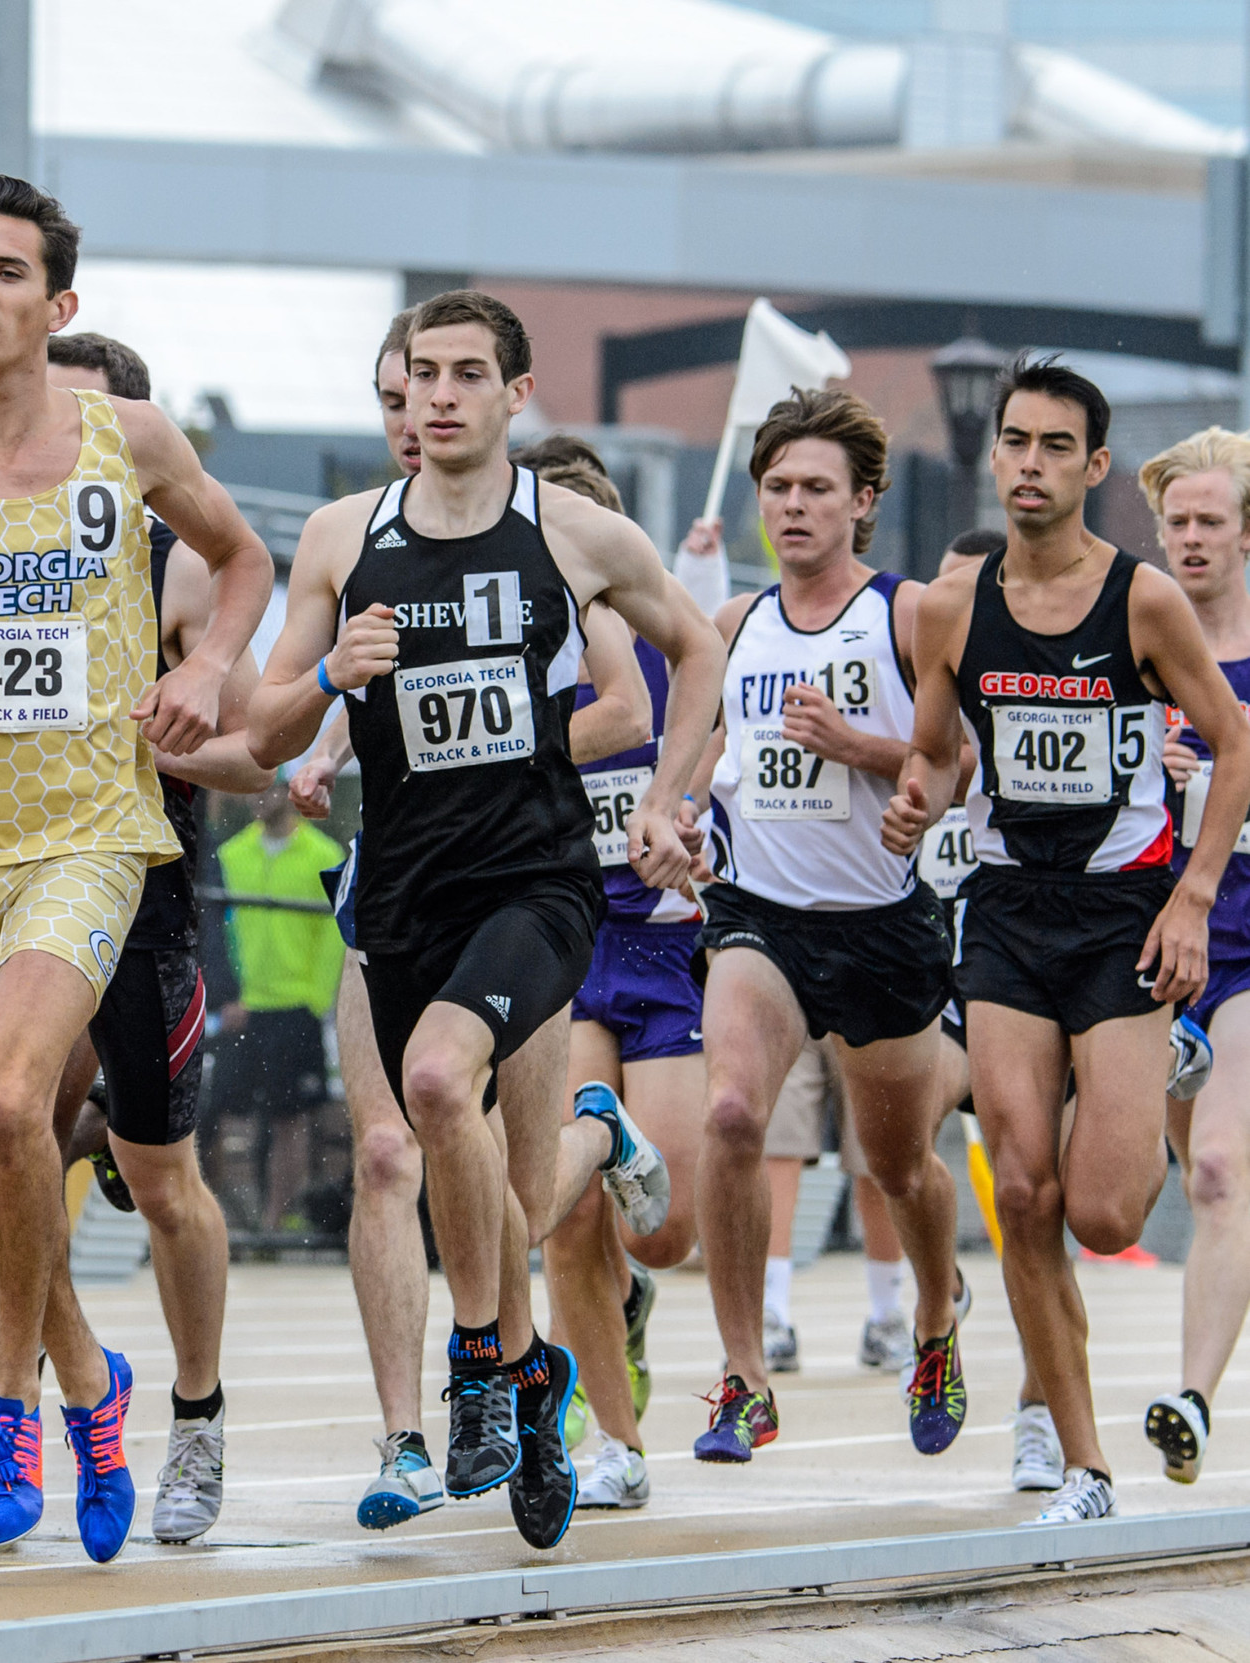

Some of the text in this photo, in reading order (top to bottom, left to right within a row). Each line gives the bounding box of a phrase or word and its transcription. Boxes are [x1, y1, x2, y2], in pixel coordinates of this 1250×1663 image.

[77, 485, 117, 552] 9
[375, 538, 407, 549] adidas
[393, 600, 533, 629] SHEVE
[473, 578, 502, 641] 1
[37, 628, 69, 640] TECH
[404, 667, 516, 691] GEORGIA TECH
[818, 661, 869, 705] 13
[979, 672, 1114, 700] GEORGIA
[18, 709, 27, 720] &
[33, 708, 69, 720] FIELD
[418, 686, 513, 745] 970
[1008, 711, 1092, 724] GEORGIA TECH
[754, 730, 782, 741] GEOR
[1118, 712, 1146, 769] 5
[418, 739, 525, 765] TRACK & FIELD
[1014, 730, 1087, 772] 402
[612, 775, 638, 787] TECH
[758, 748, 825, 789] 387
[1012, 781, 1094, 793] TRACK & FIELD
[592, 792, 635, 834] 56
[754, 798, 832, 810] TRACK & FIELD
[937, 828, 979, 866] 40
